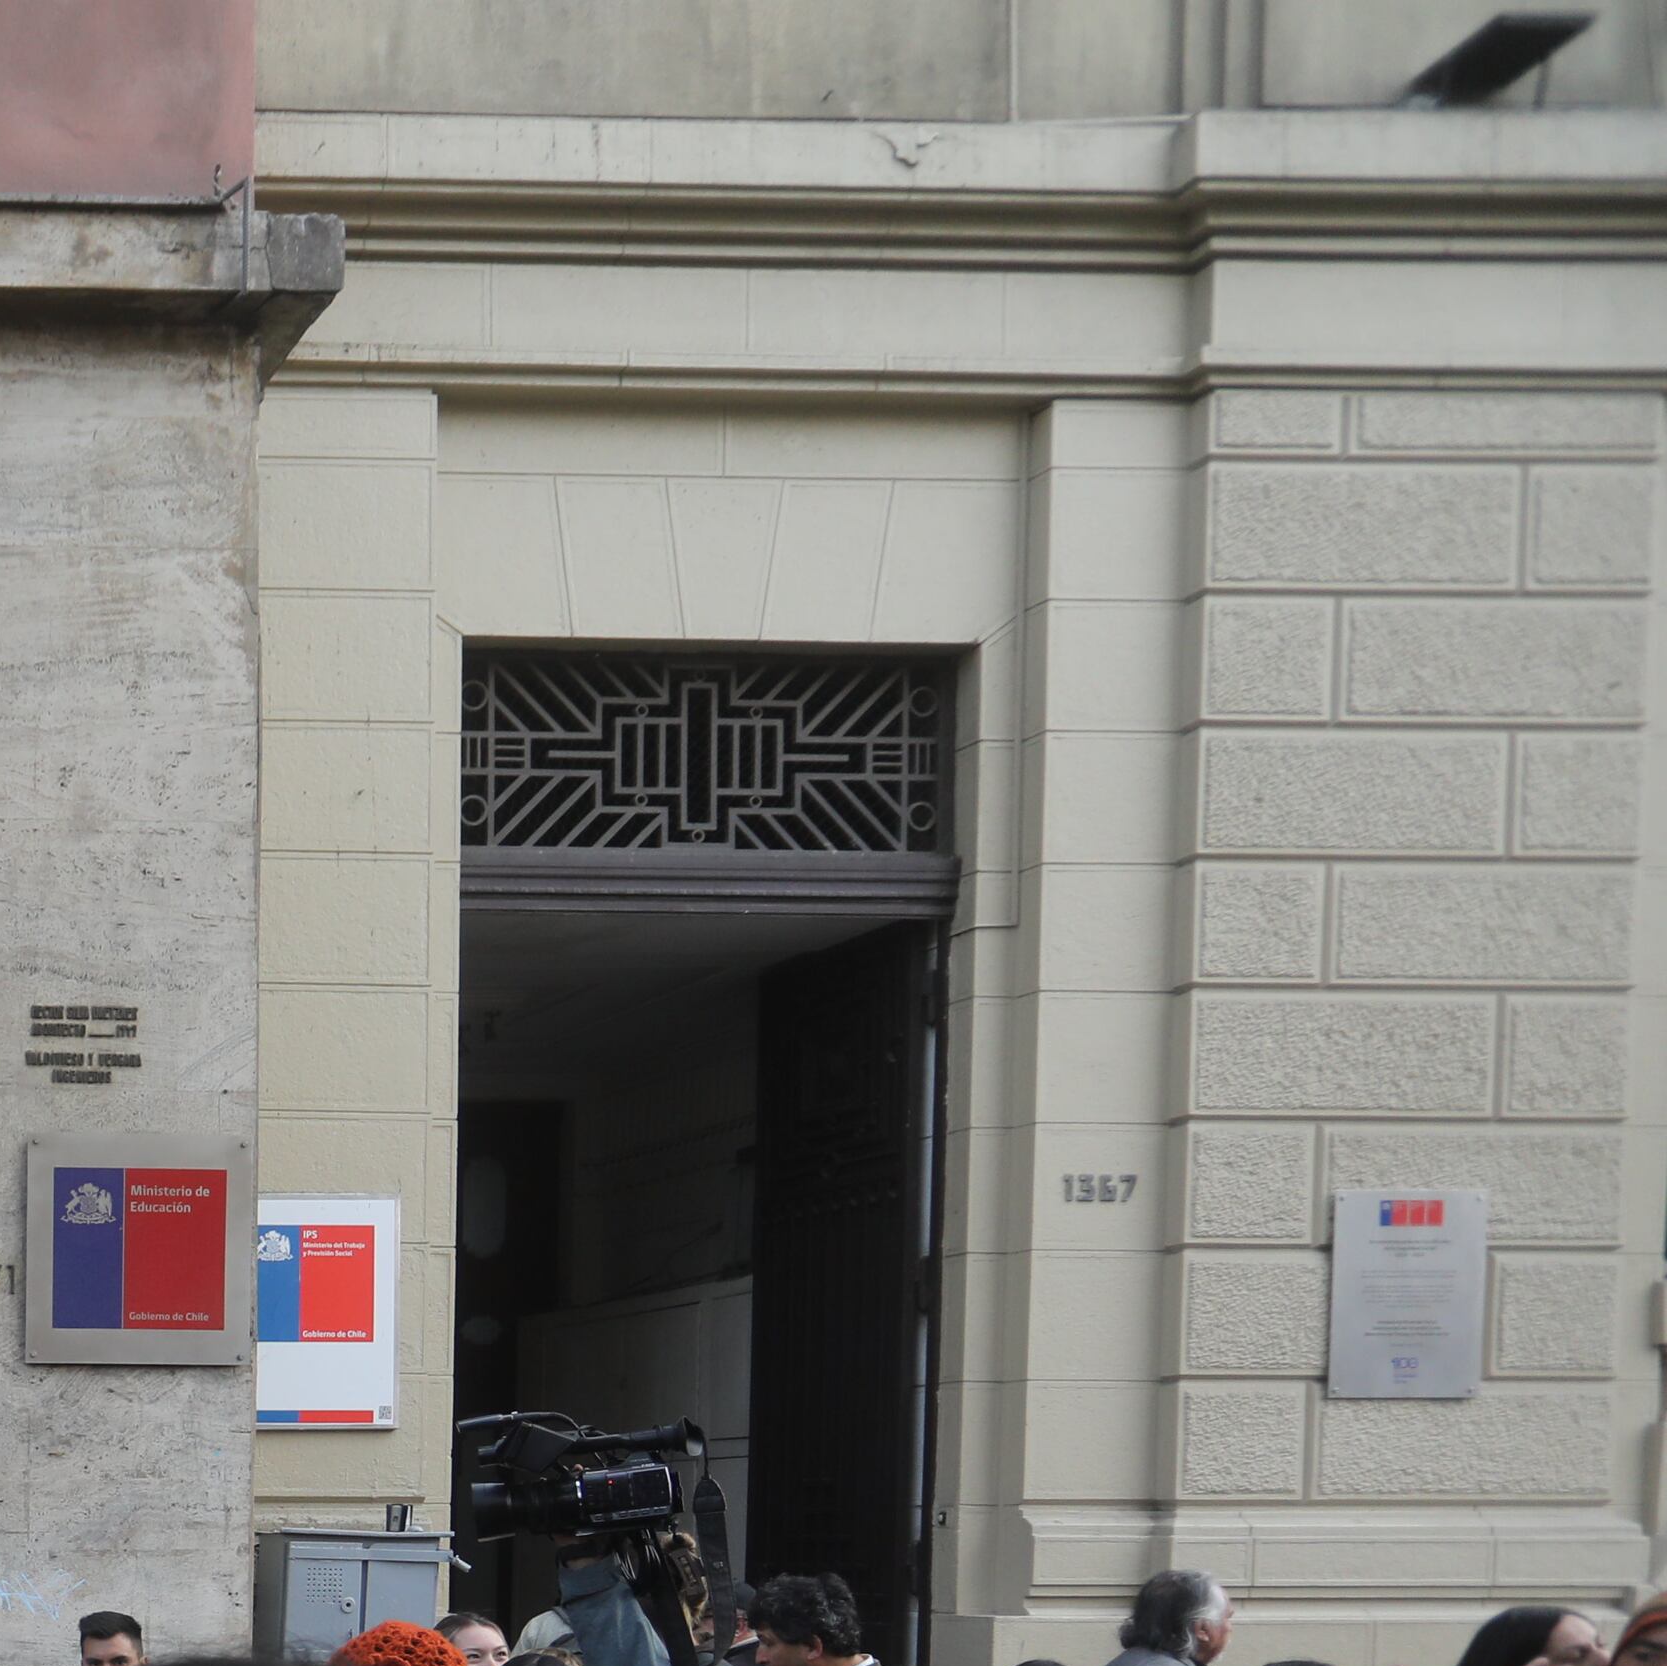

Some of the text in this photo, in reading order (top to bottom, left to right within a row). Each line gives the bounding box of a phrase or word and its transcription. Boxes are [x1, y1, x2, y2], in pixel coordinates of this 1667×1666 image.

[131, 1185, 210, 1197] Ministerio de
[1063, 1174, 1138, 1202] 1367
[130, 1201, 191, 1213] Educación
[302, 1230, 318, 1239] IPS
[344, 1242, 365, 1250] Trabajo
[129, 1312, 209, 1322] Gobierno de Chile
[302, 1330, 366, 1338] Gobierno de Chile
